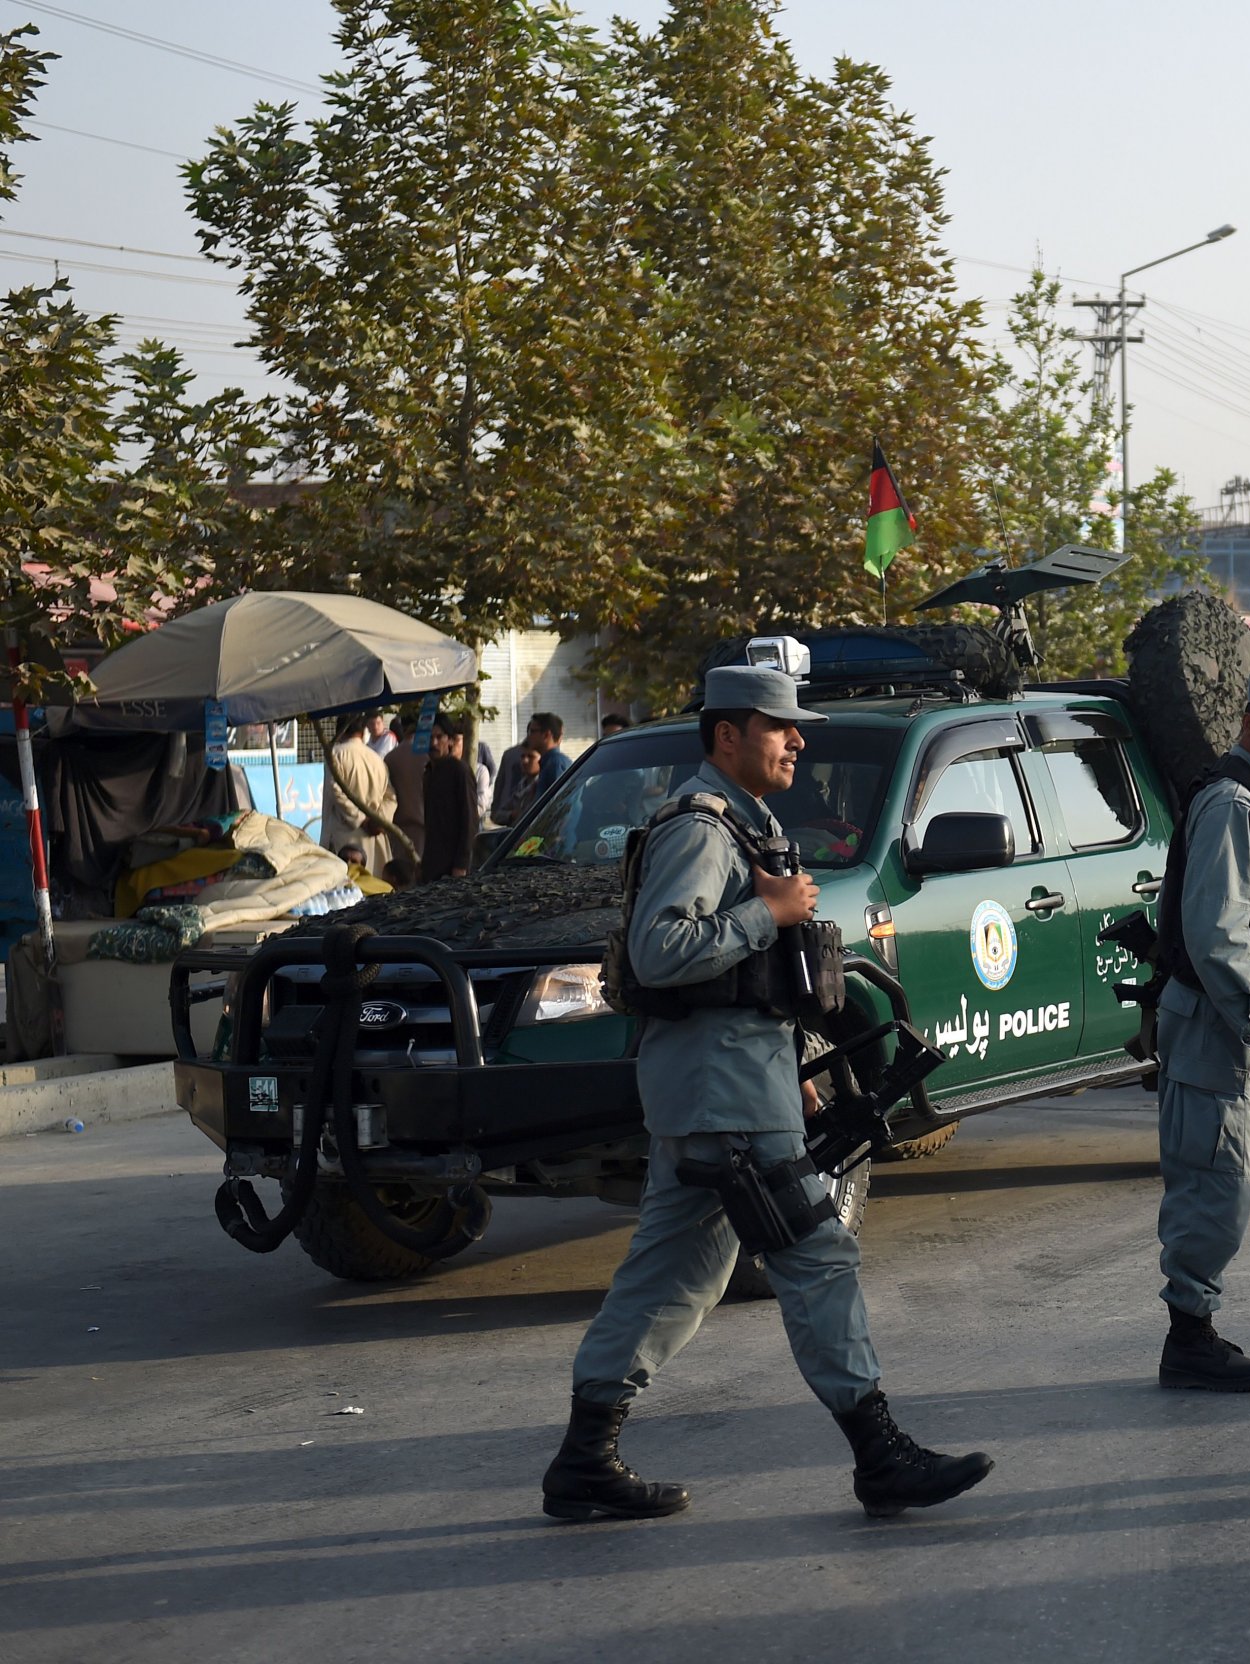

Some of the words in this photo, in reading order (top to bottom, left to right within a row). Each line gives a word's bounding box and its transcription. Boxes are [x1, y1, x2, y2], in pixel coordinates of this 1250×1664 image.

[410, 657, 443, 678] ESSE
[120, 699, 168, 718] ESSE
[360, 1006, 390, 1022] Ford
[999, 1001, 1070, 1041] POLICE
